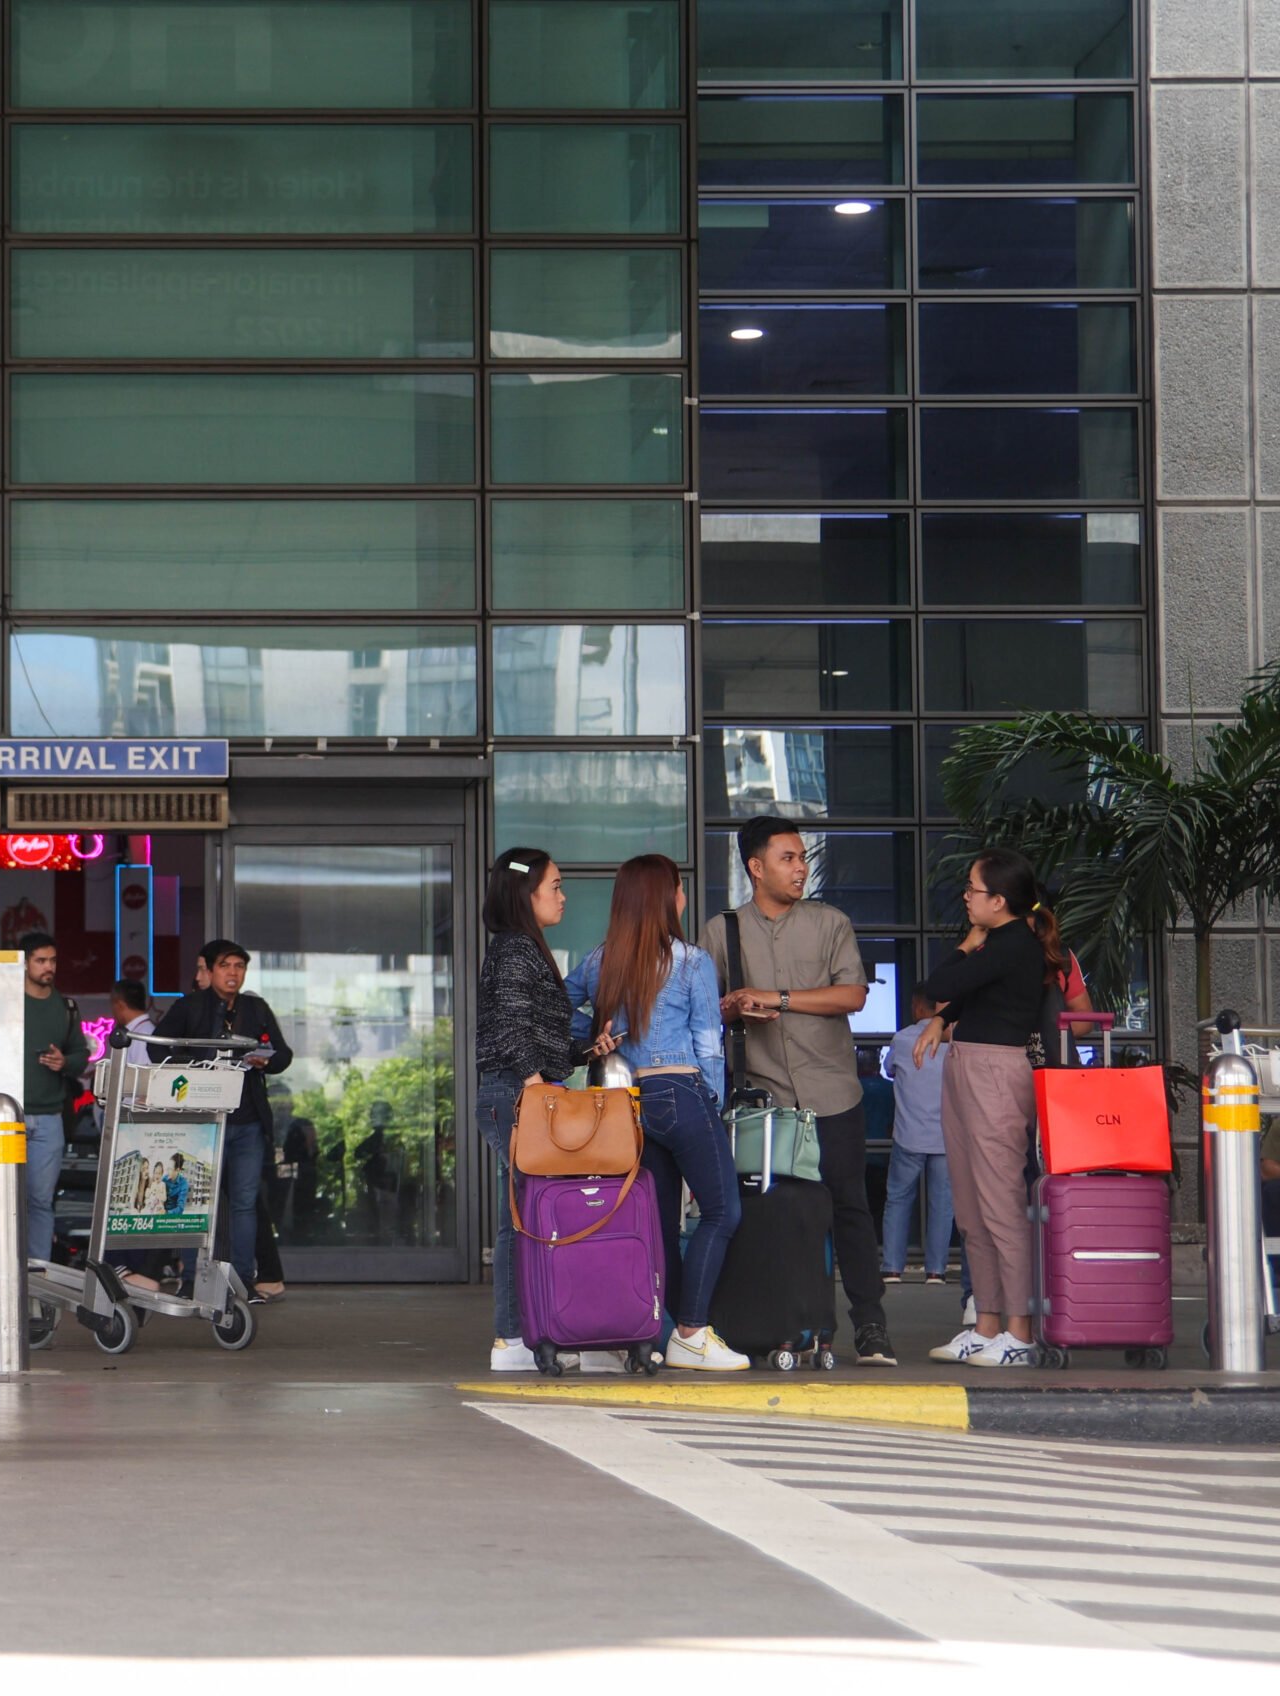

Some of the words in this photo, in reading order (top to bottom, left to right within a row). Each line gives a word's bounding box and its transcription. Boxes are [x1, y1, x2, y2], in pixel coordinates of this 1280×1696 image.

[127, 747, 201, 771] EXIT
[1095, 1114, 1121, 1126] CLN
[111, 1217, 155, 1231] 856-7864
